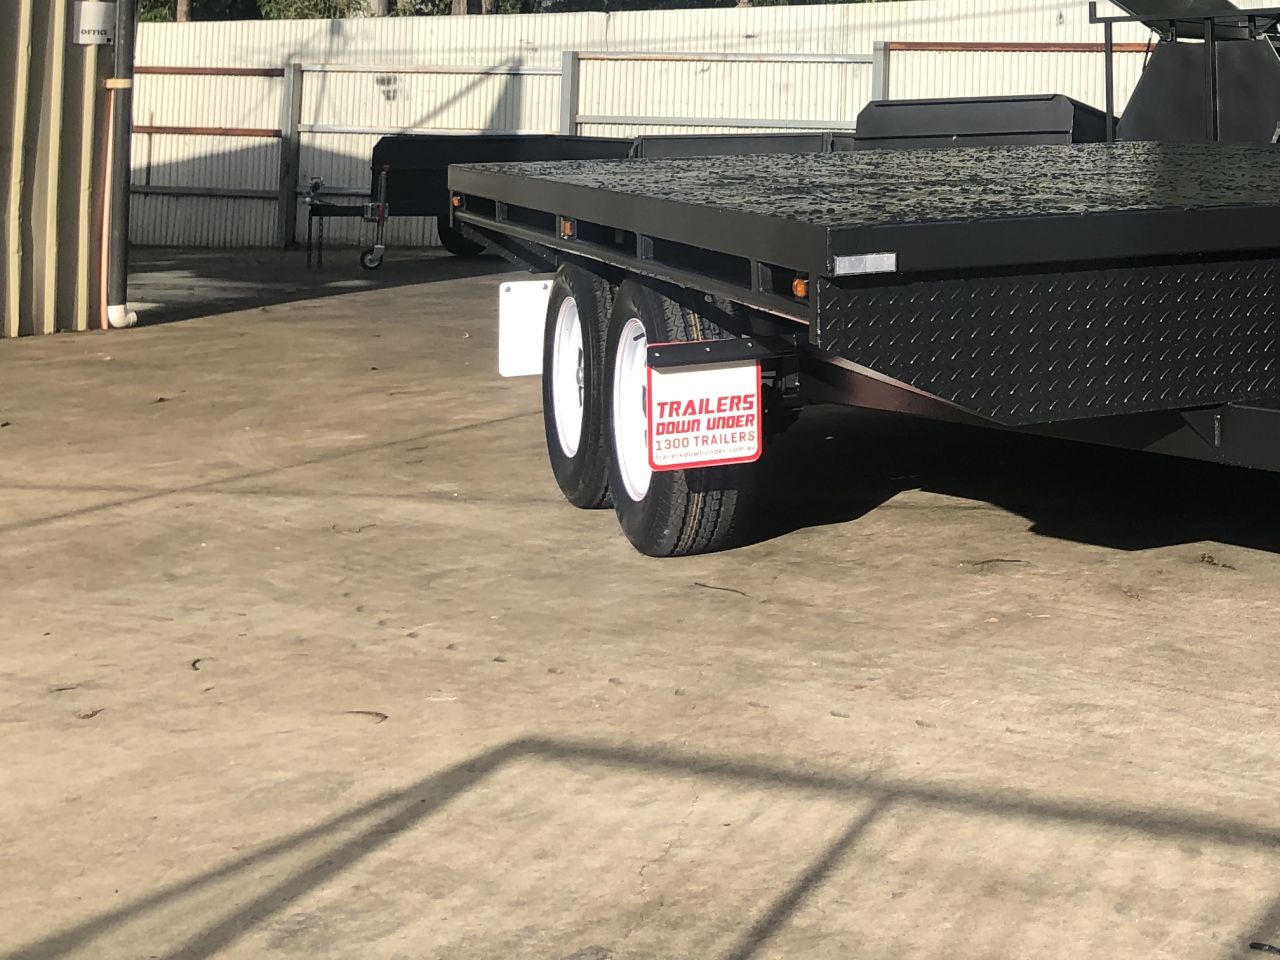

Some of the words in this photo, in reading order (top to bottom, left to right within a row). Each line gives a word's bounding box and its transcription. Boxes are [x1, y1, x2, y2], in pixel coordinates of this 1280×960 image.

[657, 394, 755, 419] TRAILERS
[656, 419, 701, 436] DOWN
[706, 414, 755, 431] UNDER
[656, 437, 689, 451] 1300
[693, 430, 755, 447] TRAILERS
